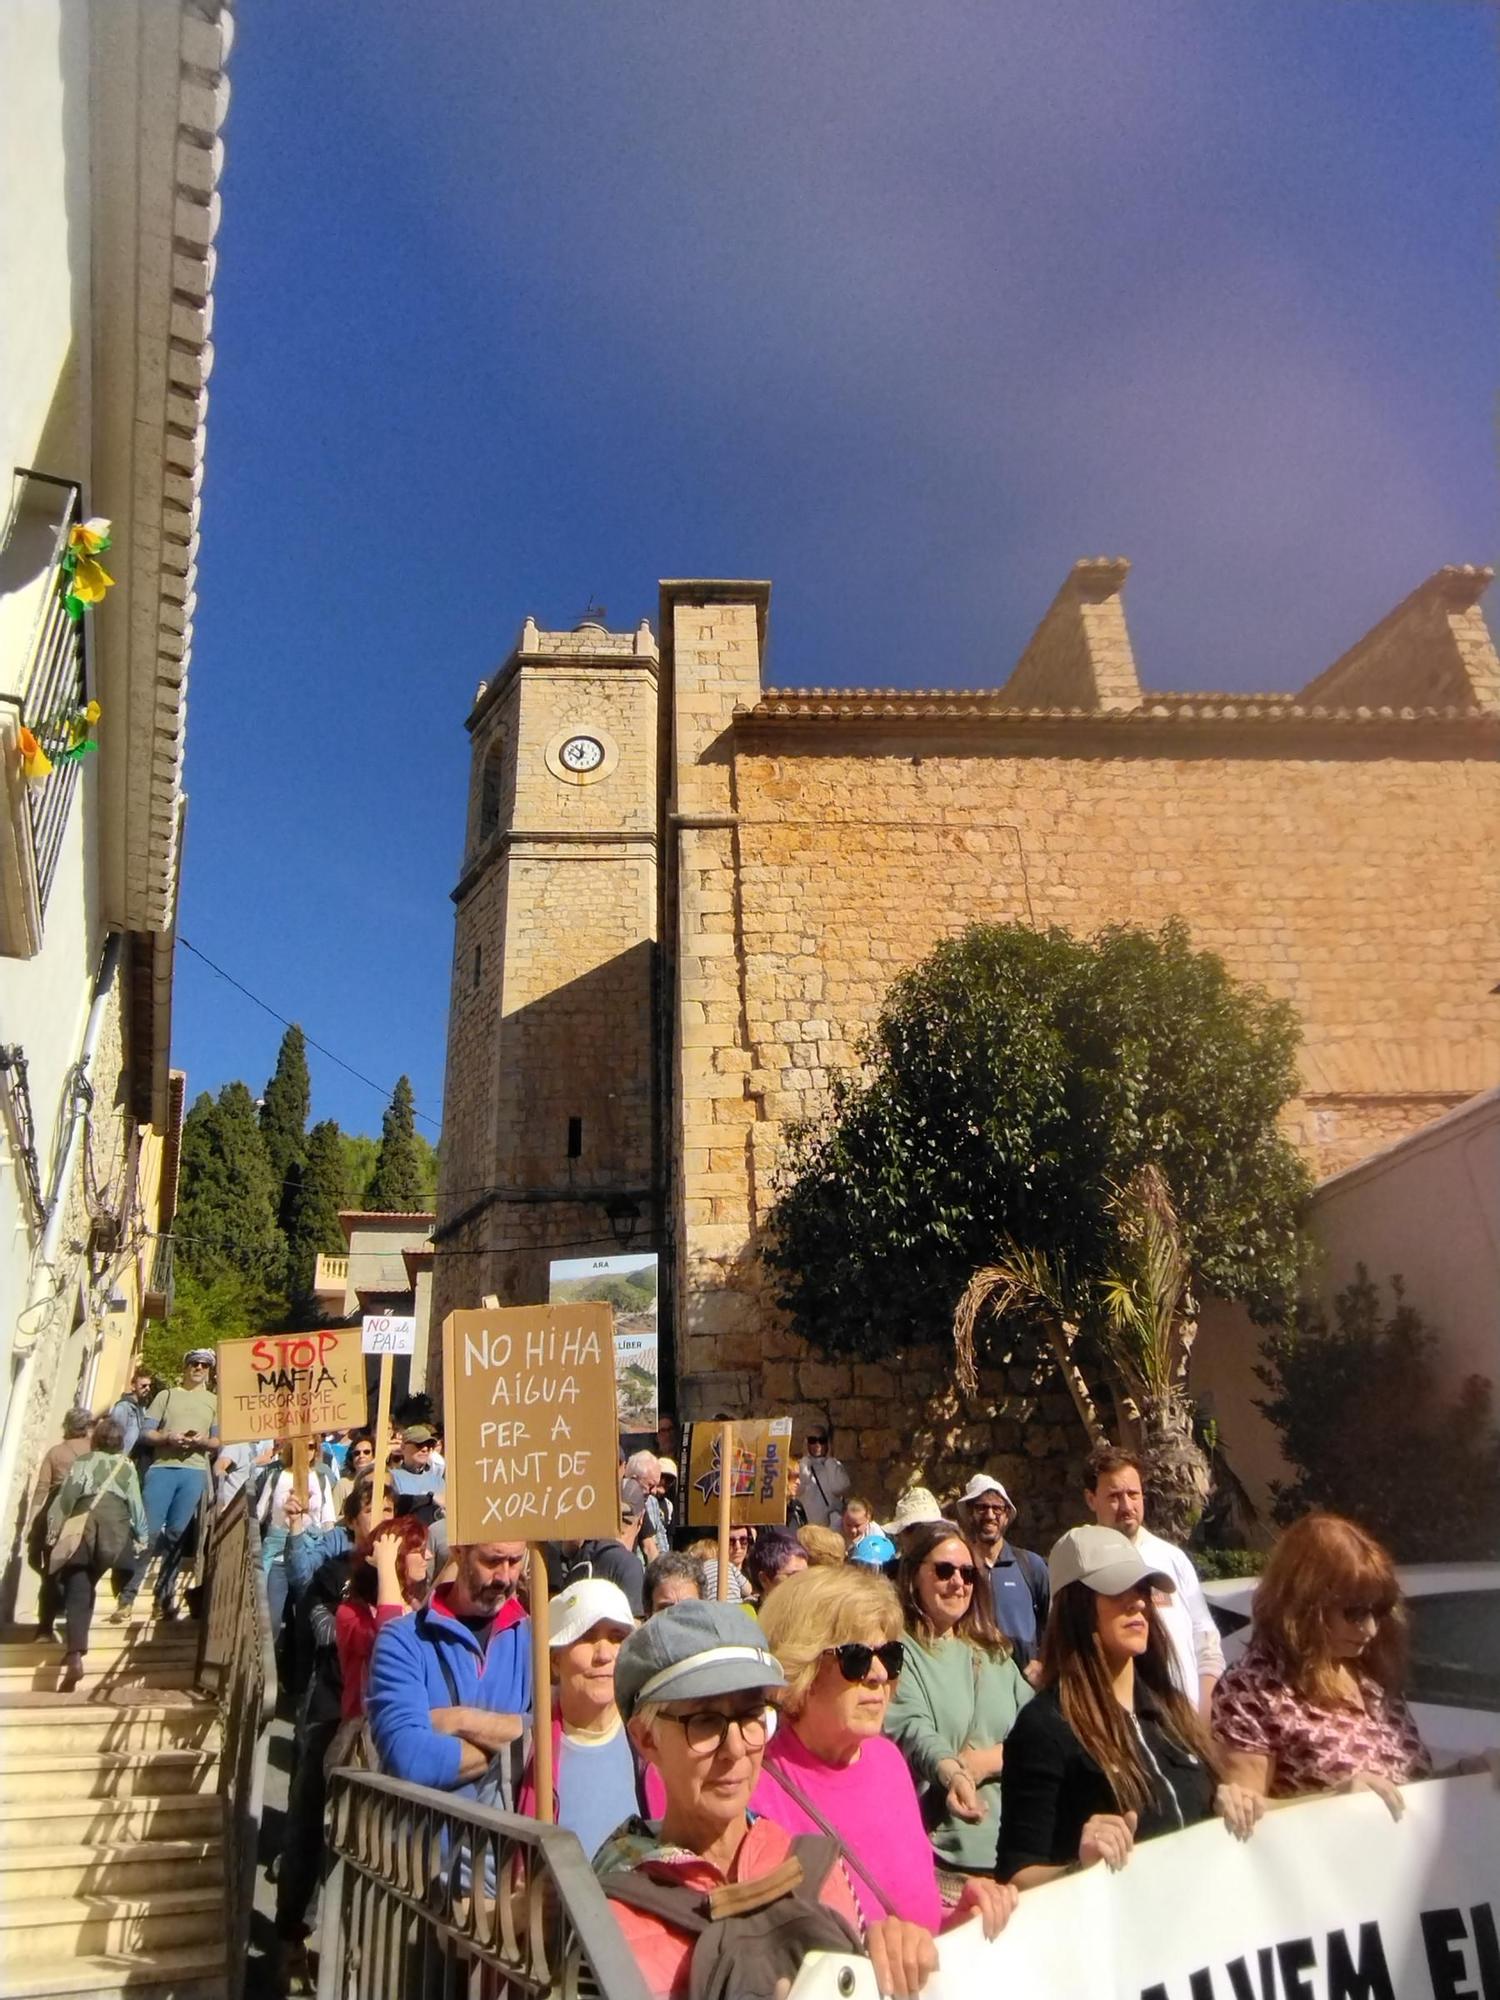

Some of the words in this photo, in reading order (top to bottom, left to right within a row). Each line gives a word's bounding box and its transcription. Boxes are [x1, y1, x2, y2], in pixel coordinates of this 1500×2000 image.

[592, 1260, 609, 1269] ARA
[367, 1319, 390, 1333] NO
[252, 1332, 338, 1370] STOP
[463, 1329, 512, 1377] NO
[343, 1369, 348, 1384] i
[234, 1390, 332, 1411] TERRORISME
[480, 1421, 531, 1448] PER
[551, 1414, 572, 1441] A
[475, 1451, 548, 1485] TANT
[558, 1451, 591, 1480] DE
[1140, 1920, 1396, 2000] VEM
